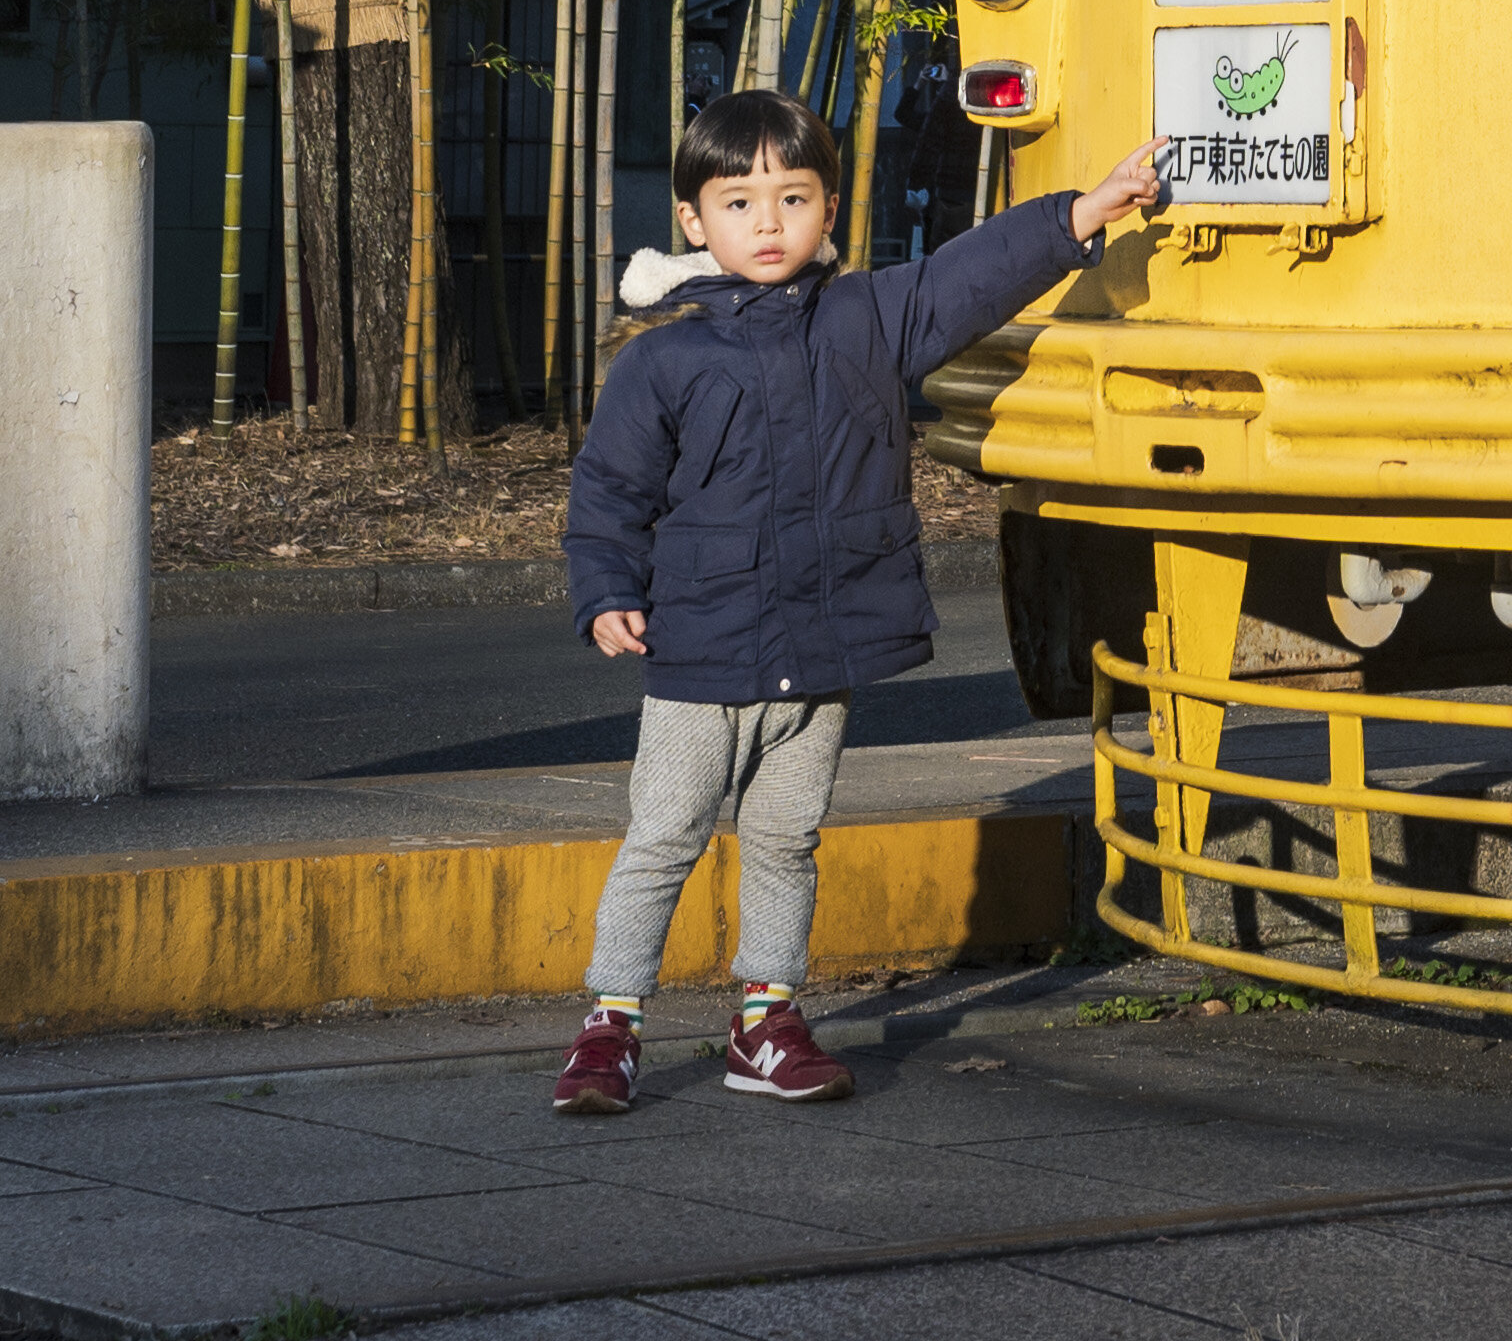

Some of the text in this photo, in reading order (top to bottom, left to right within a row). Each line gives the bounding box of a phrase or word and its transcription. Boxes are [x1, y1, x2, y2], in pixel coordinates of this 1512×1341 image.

[1167, 131, 1329, 185] 江戸東京たてもの園
